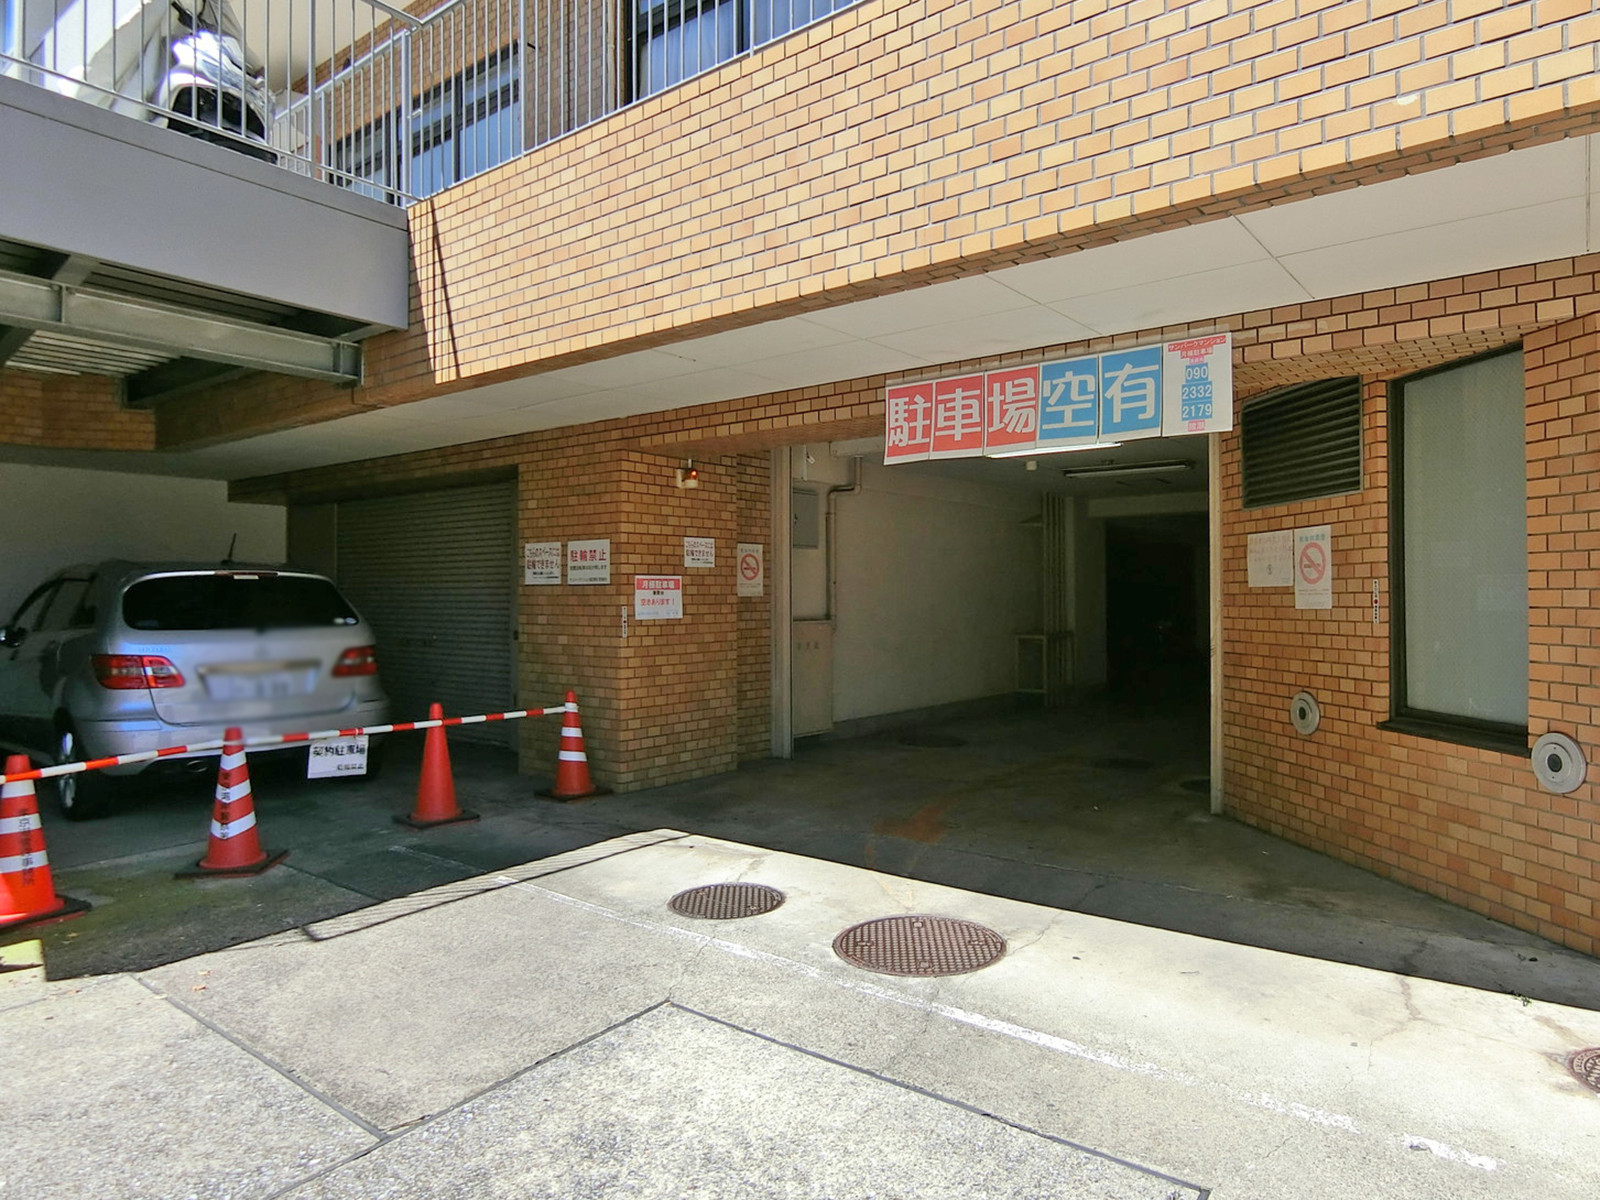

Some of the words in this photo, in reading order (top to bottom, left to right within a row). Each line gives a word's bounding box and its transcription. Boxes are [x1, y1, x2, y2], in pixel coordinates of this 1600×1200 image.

[1185, 366, 1208, 380] 090
[1182, 385, 1212, 399] 2332
[888, 363, 1160, 447] 駐車場空有
[1182, 403, 1212, 418] 2179
[570, 549, 607, 562] 駐輪禁止
[313, 744, 366, 757] 契約駐車場
